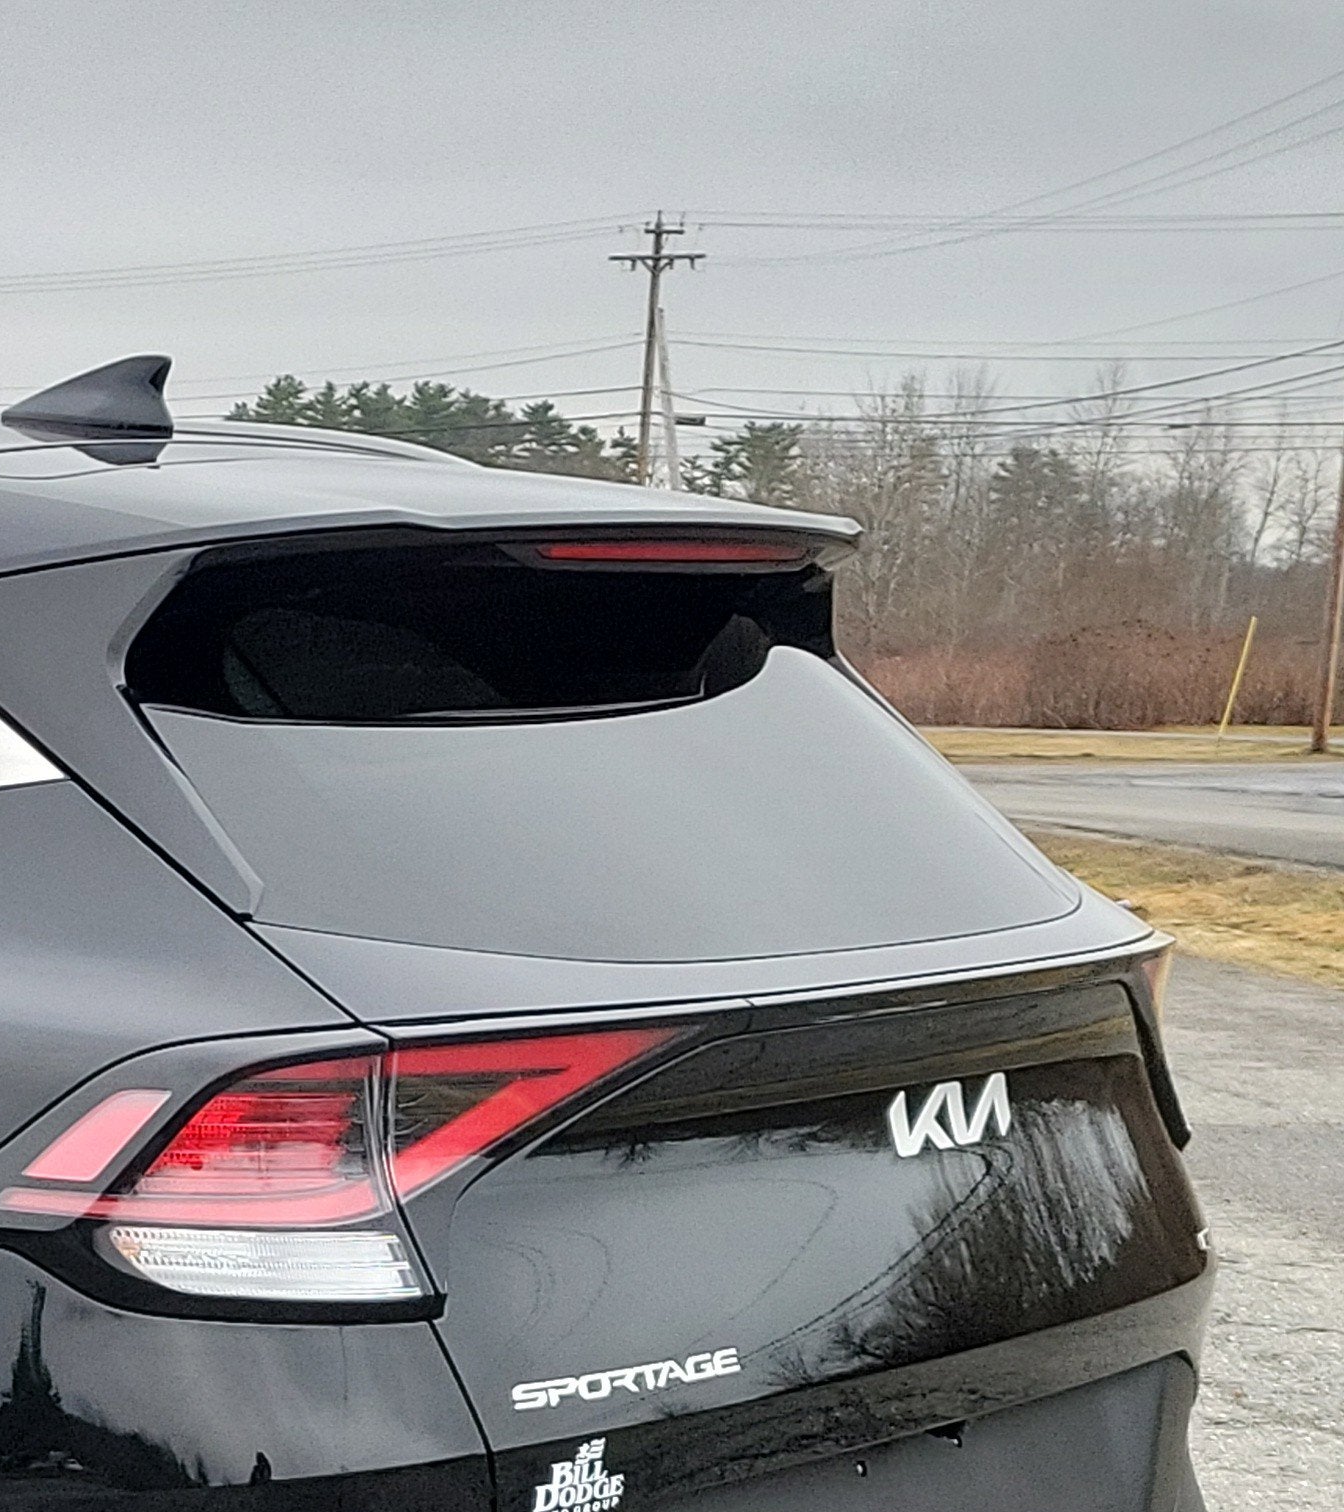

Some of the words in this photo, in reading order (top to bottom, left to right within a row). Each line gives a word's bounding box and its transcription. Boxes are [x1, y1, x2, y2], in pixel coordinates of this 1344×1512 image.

[511, 1348, 741, 1410] SPORTAGE
[532, 1473, 625, 1512] DODGE
[551, 1461, 608, 1489] BILL
